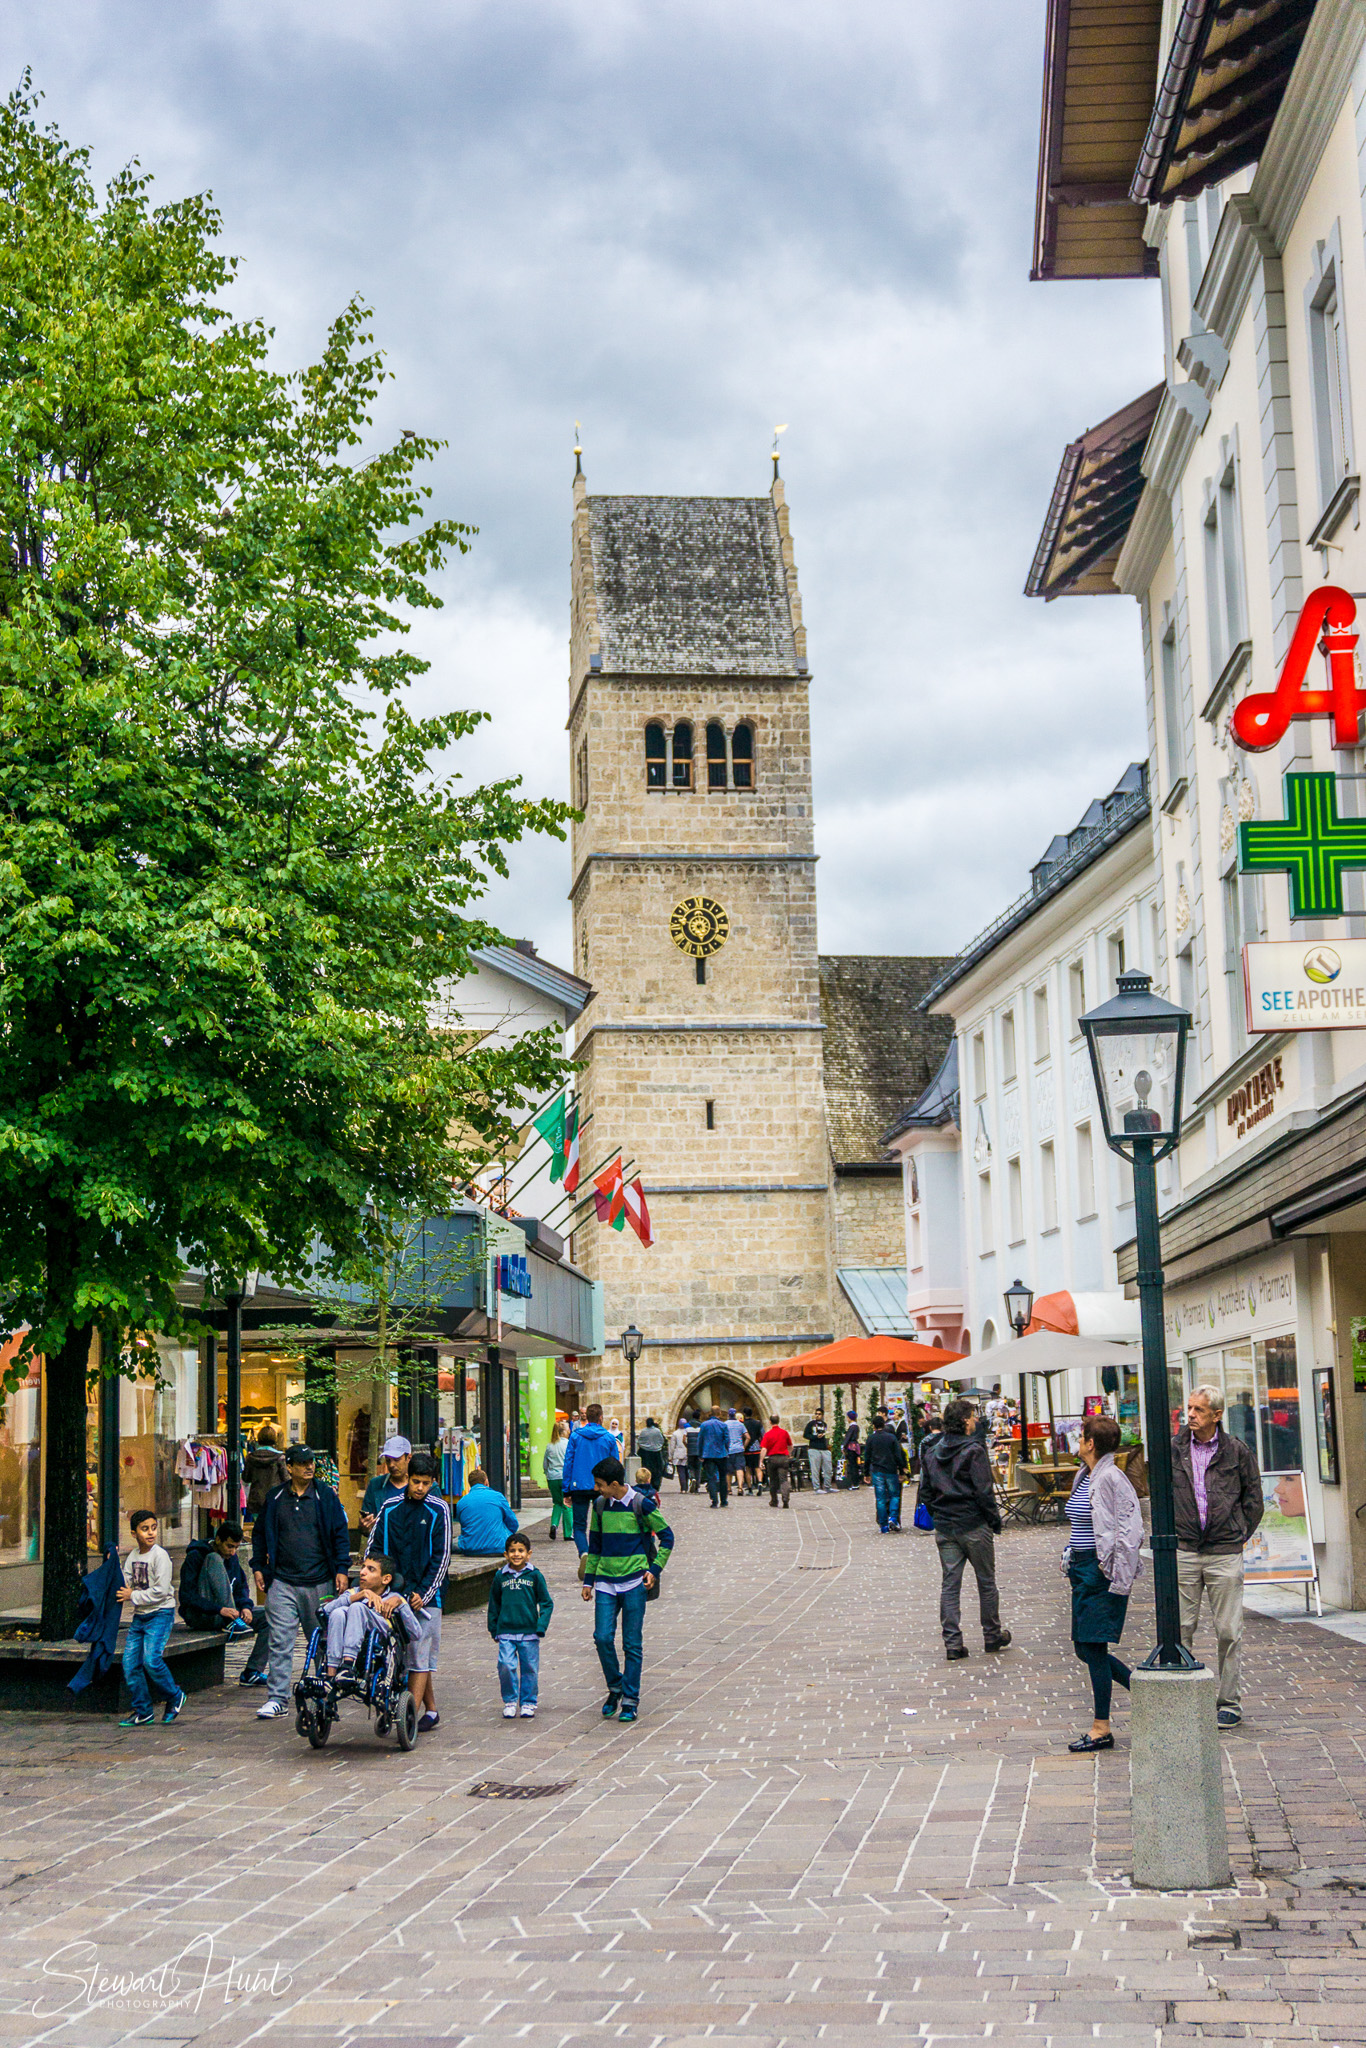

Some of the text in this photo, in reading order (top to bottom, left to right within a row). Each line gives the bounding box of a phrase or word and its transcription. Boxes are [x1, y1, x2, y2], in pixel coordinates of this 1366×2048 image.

[1283, 1010, 1366, 1022] ZELL AM SE
[1227, 1055, 1284, 1126] APOTHEKE
[1183, 1303, 1206, 1329] Pharmacy
[1217, 1285, 1246, 1324] Apotheke
[1258, 1273, 1293, 1306] Pharmacy
